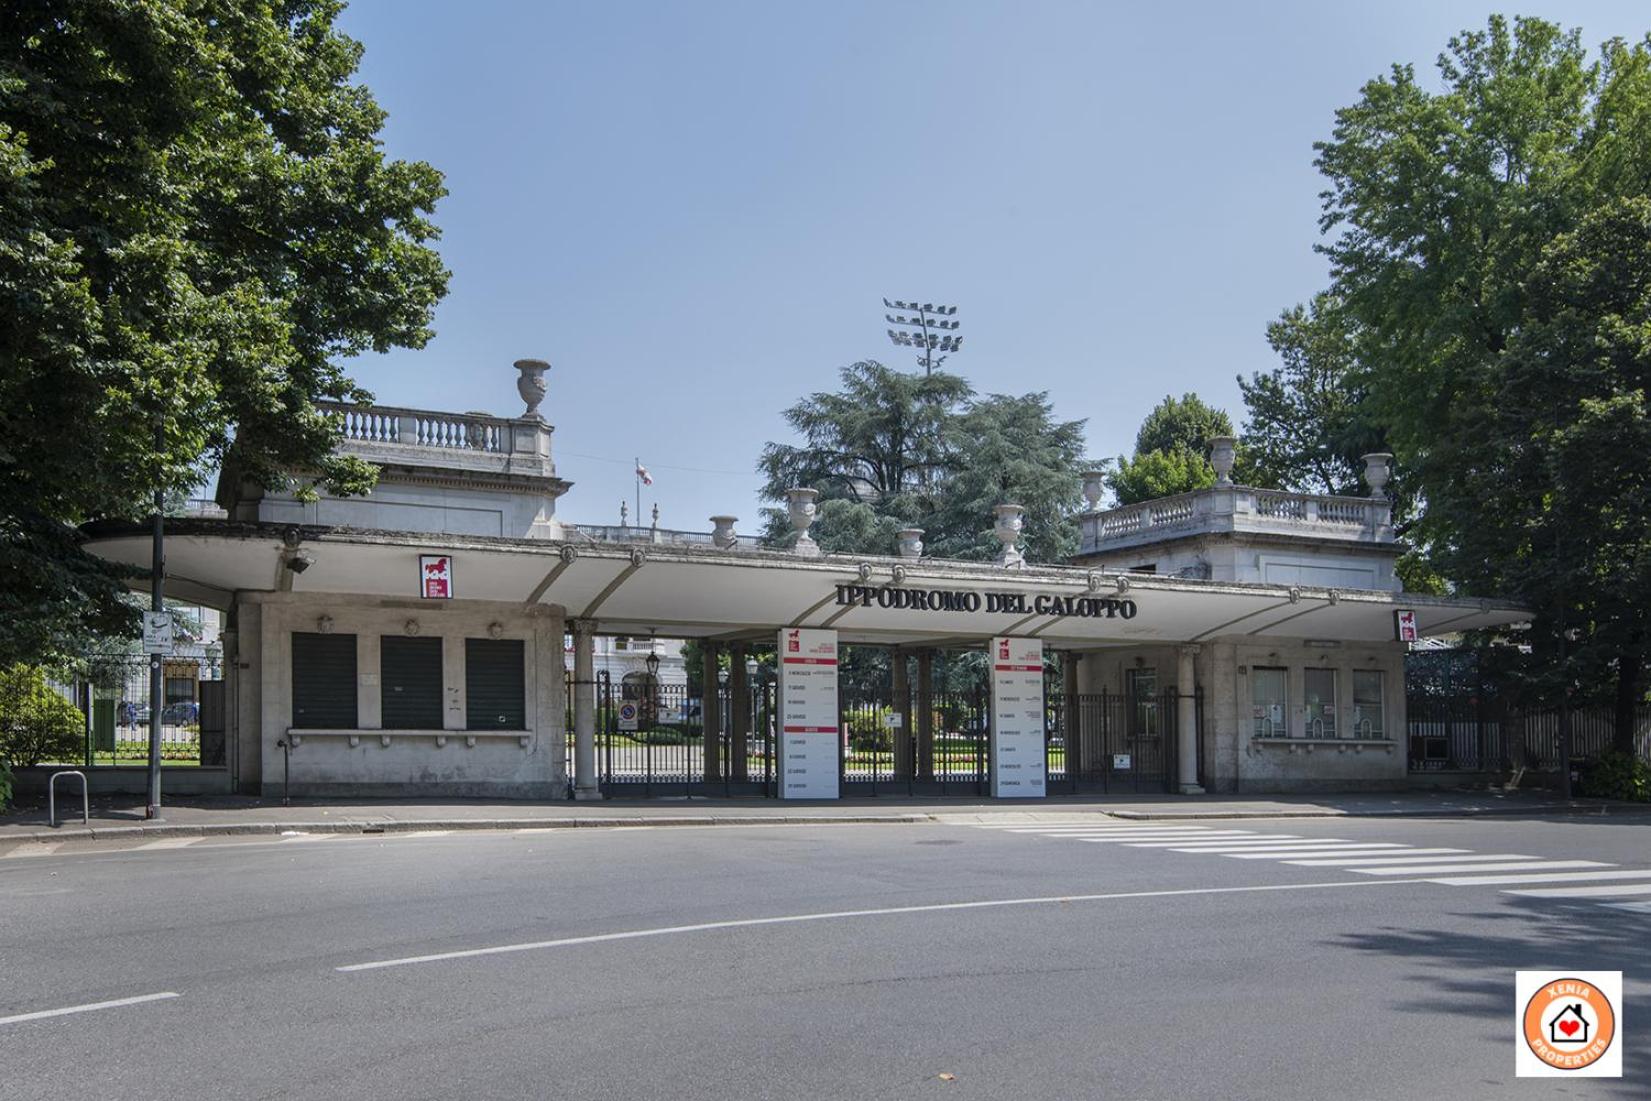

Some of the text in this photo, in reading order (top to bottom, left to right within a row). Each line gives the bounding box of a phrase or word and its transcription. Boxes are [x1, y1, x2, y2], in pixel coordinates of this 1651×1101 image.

[835, 584, 1137, 619] IPPODROMO DEL GALOPPO
